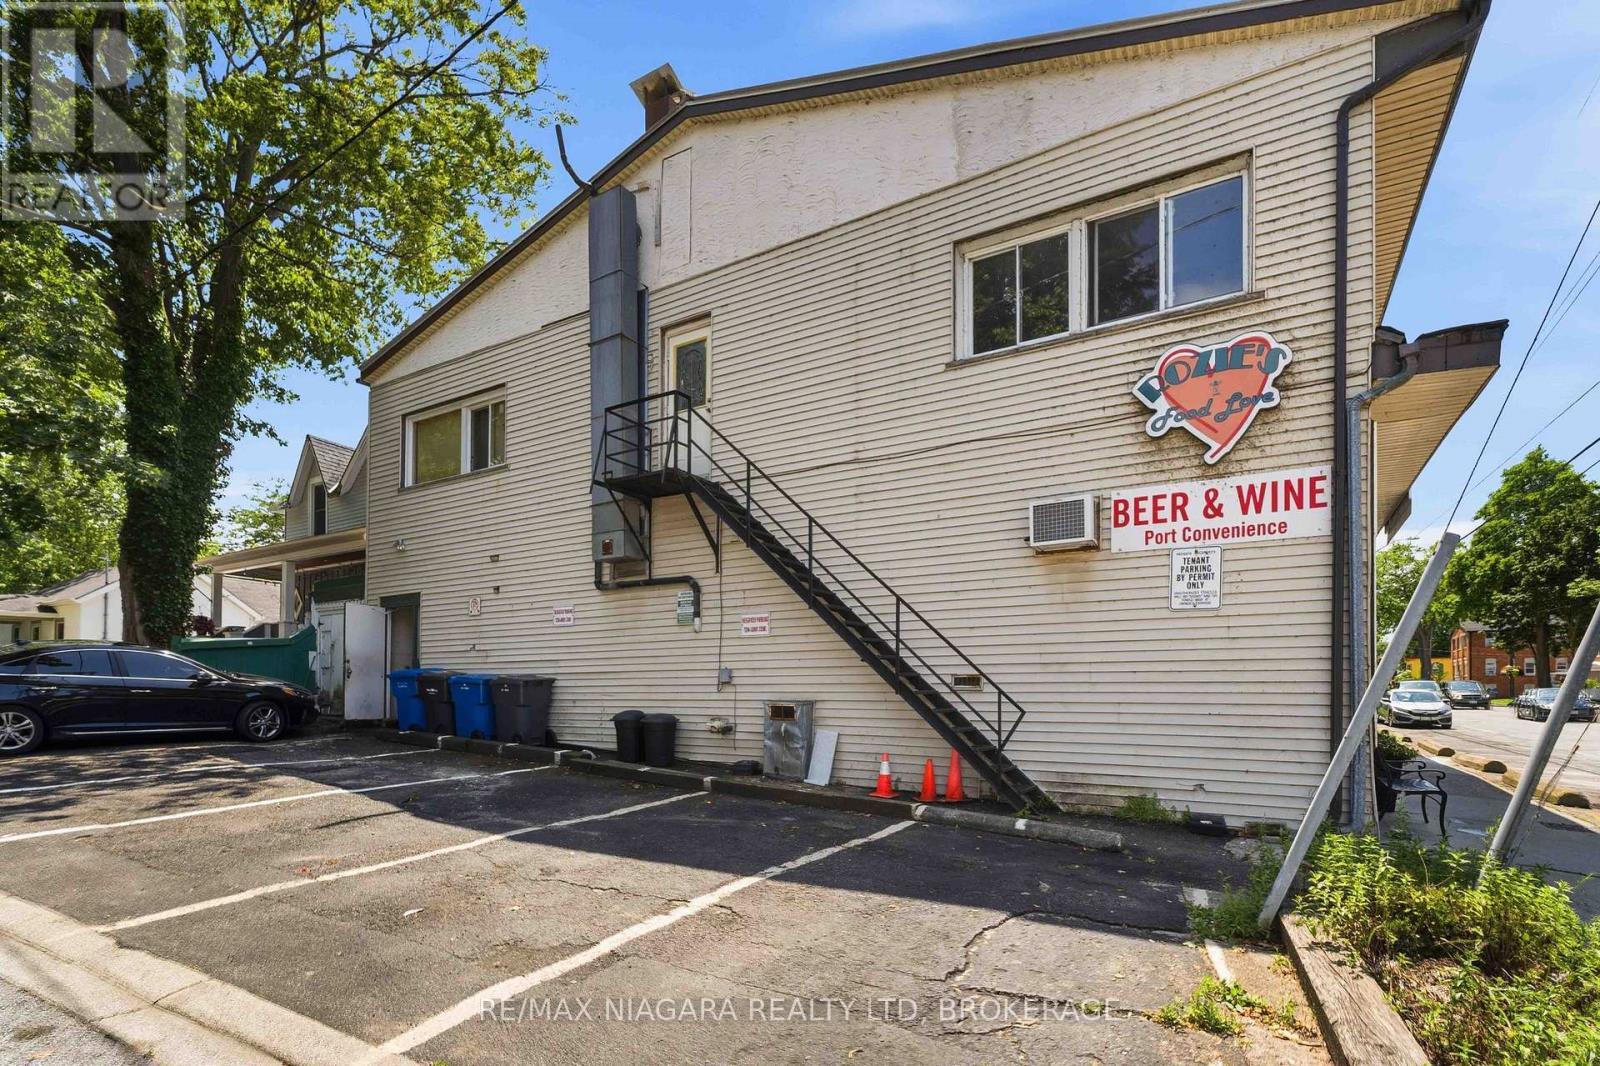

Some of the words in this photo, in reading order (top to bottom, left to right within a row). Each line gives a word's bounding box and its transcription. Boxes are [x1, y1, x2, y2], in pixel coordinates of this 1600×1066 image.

[1214, 391, 1275, 423] Love
[1113, 491, 1189, 528] BEER
[1202, 487, 1224, 519] &
[1235, 474, 1328, 516] WINE
[1144, 529, 1177, 545] Port
[1182, 521, 1288, 542] Convenience
[1182, 556, 1210, 565] TENANT
[1180, 565, 1212, 573] PARKING
[1176, 574, 1185, 582] BY
[1188, 572, 1215, 581] PERMIT
[1186, 581, 1205, 590] ONLY
